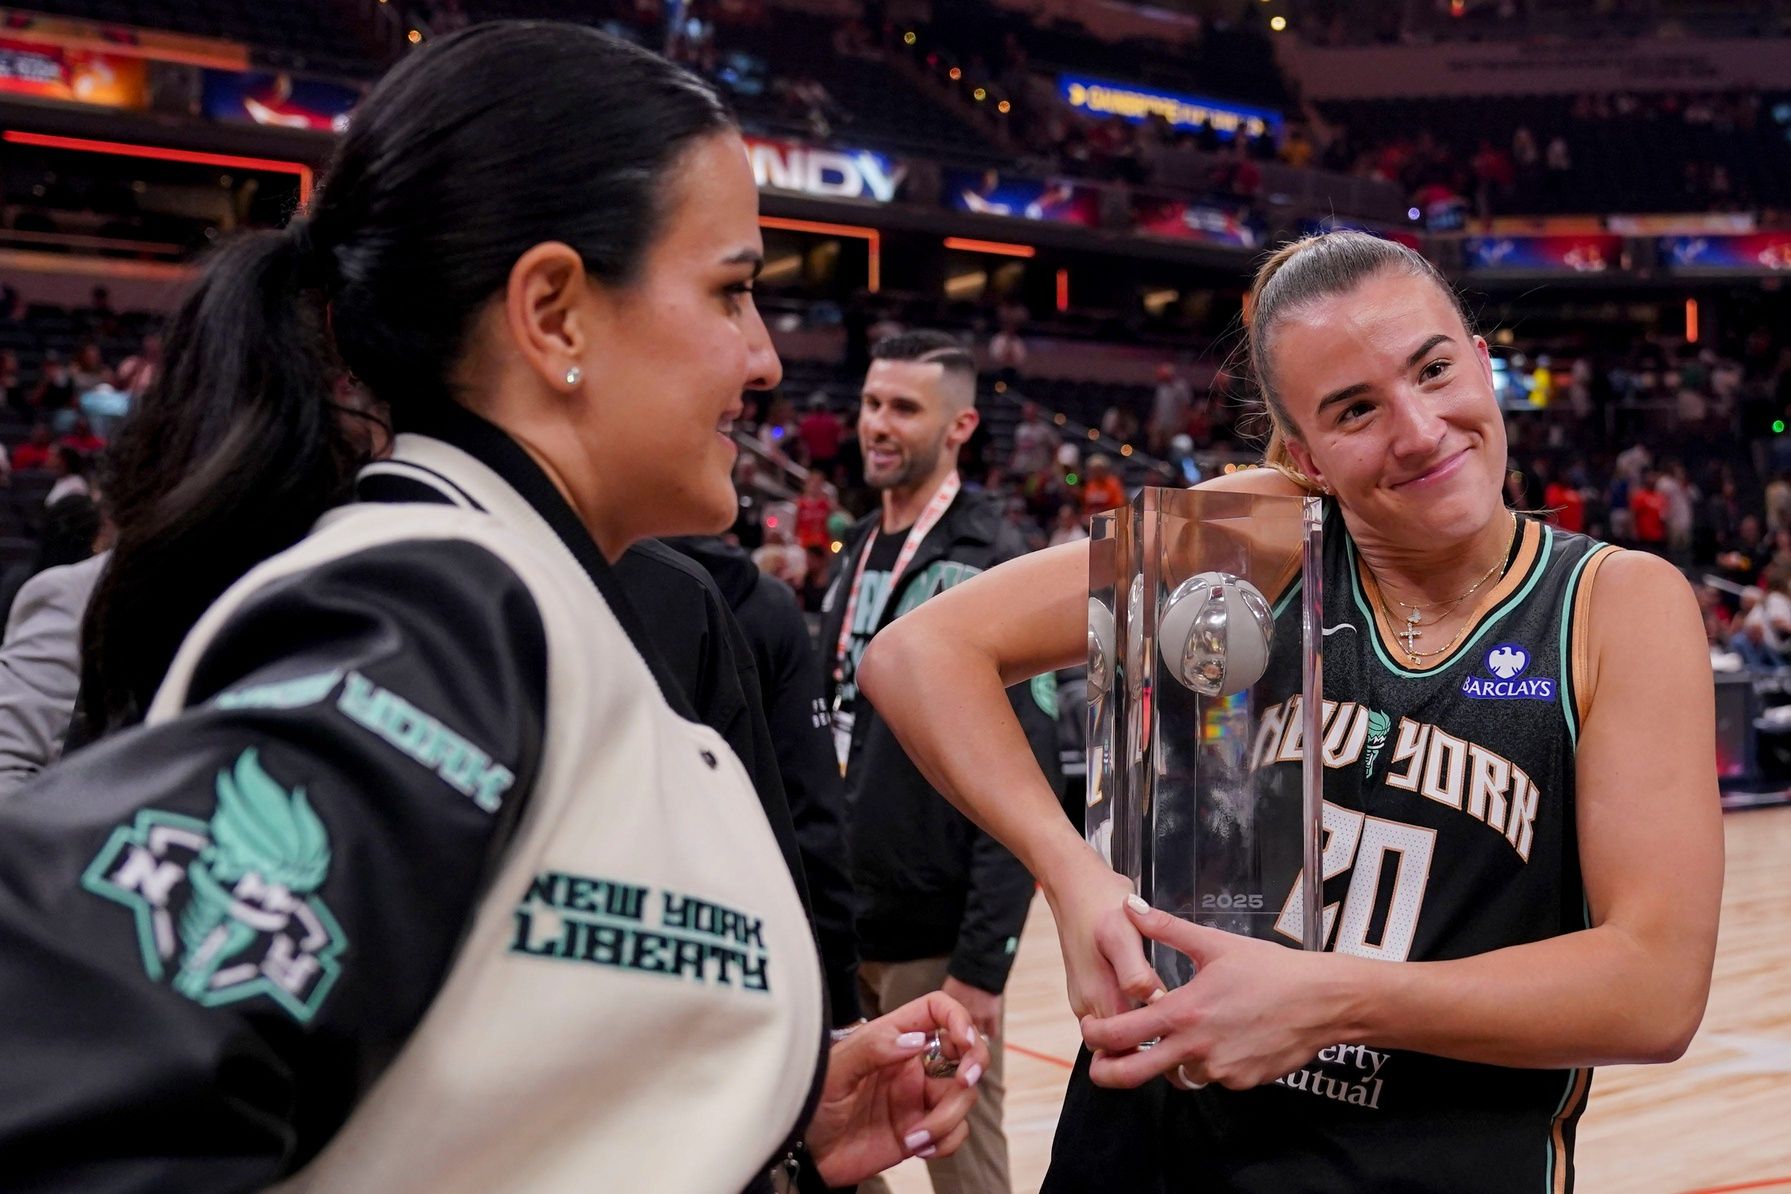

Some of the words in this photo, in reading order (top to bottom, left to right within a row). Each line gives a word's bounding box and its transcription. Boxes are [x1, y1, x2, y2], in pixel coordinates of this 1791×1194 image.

[746, 144, 905, 202] NDY
[1462, 676, 1551, 697] BARCLAYS
[1385, 715, 1540, 865] YORK
[520, 870, 650, 922] NEW
[661, 888, 766, 950] YORK
[1201, 893, 1264, 909] 2025
[1273, 799, 1438, 963] 20
[508, 910, 771, 993] LIBERTY
[1275, 1069, 1384, 1110] utual
